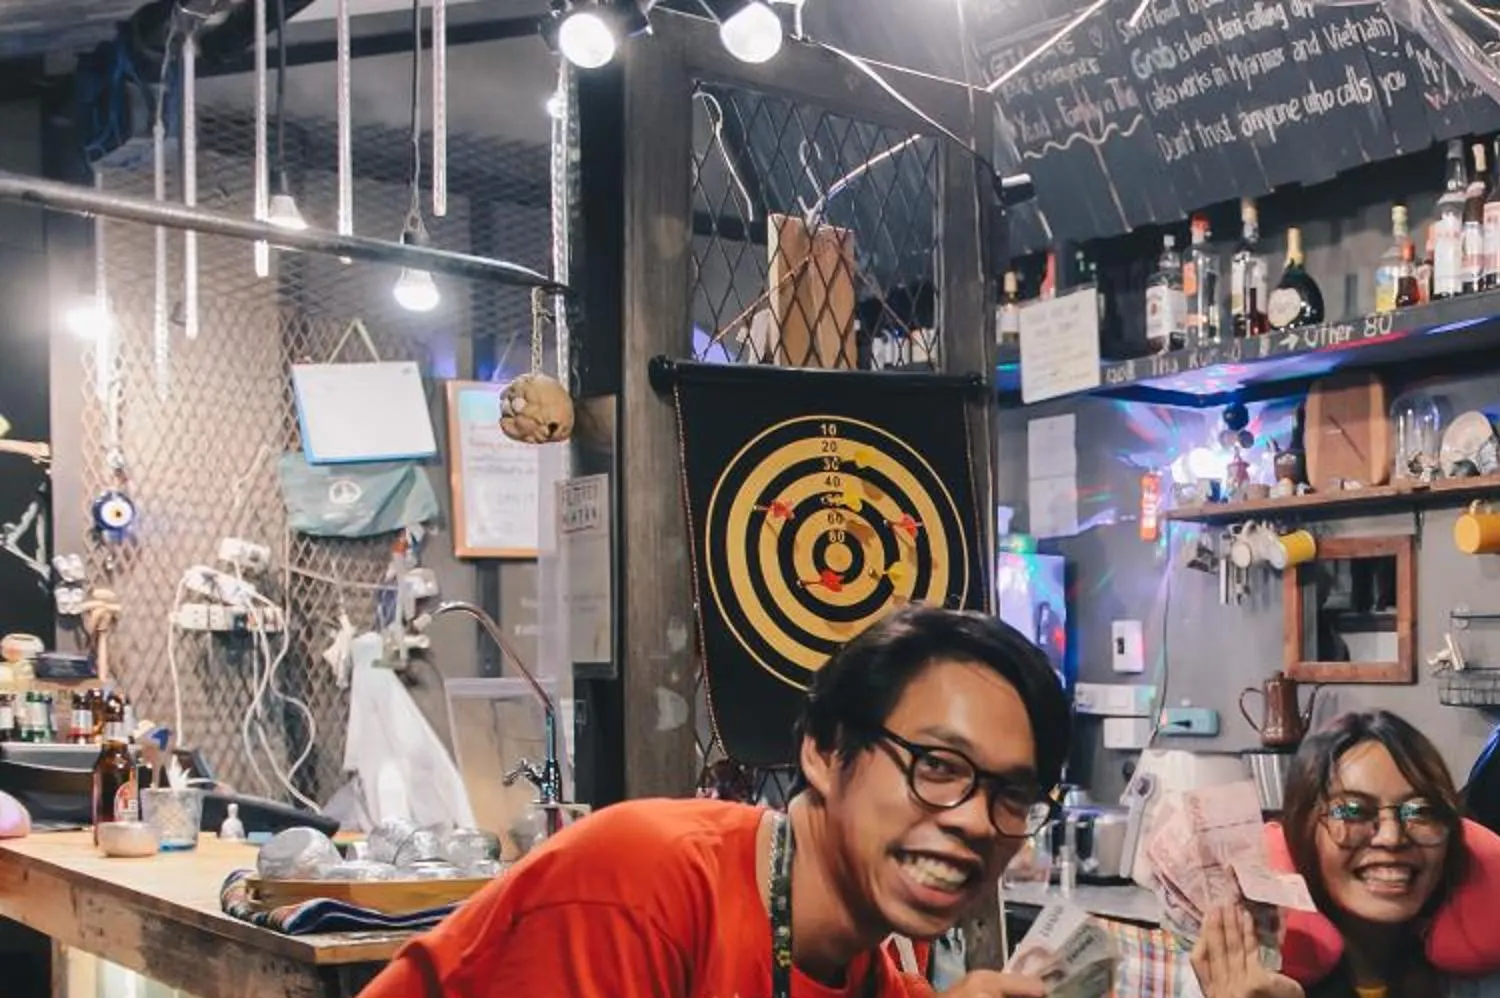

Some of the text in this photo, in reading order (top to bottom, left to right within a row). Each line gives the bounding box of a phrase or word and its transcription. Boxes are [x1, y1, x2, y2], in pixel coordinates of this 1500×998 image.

[1292, 31, 1322, 62] and
[1238, 98, 1303, 143] anyone
[1304, 79, 1335, 114] who
[1336, 65, 1374, 106] calls
[1378, 71, 1407, 107] you
[1304, 321, 1354, 348] Other
[820, 424, 837, 436] 10
[822, 441, 838, 452] 20
[823, 458, 840, 470] 30
[825, 475, 841, 487] 40
